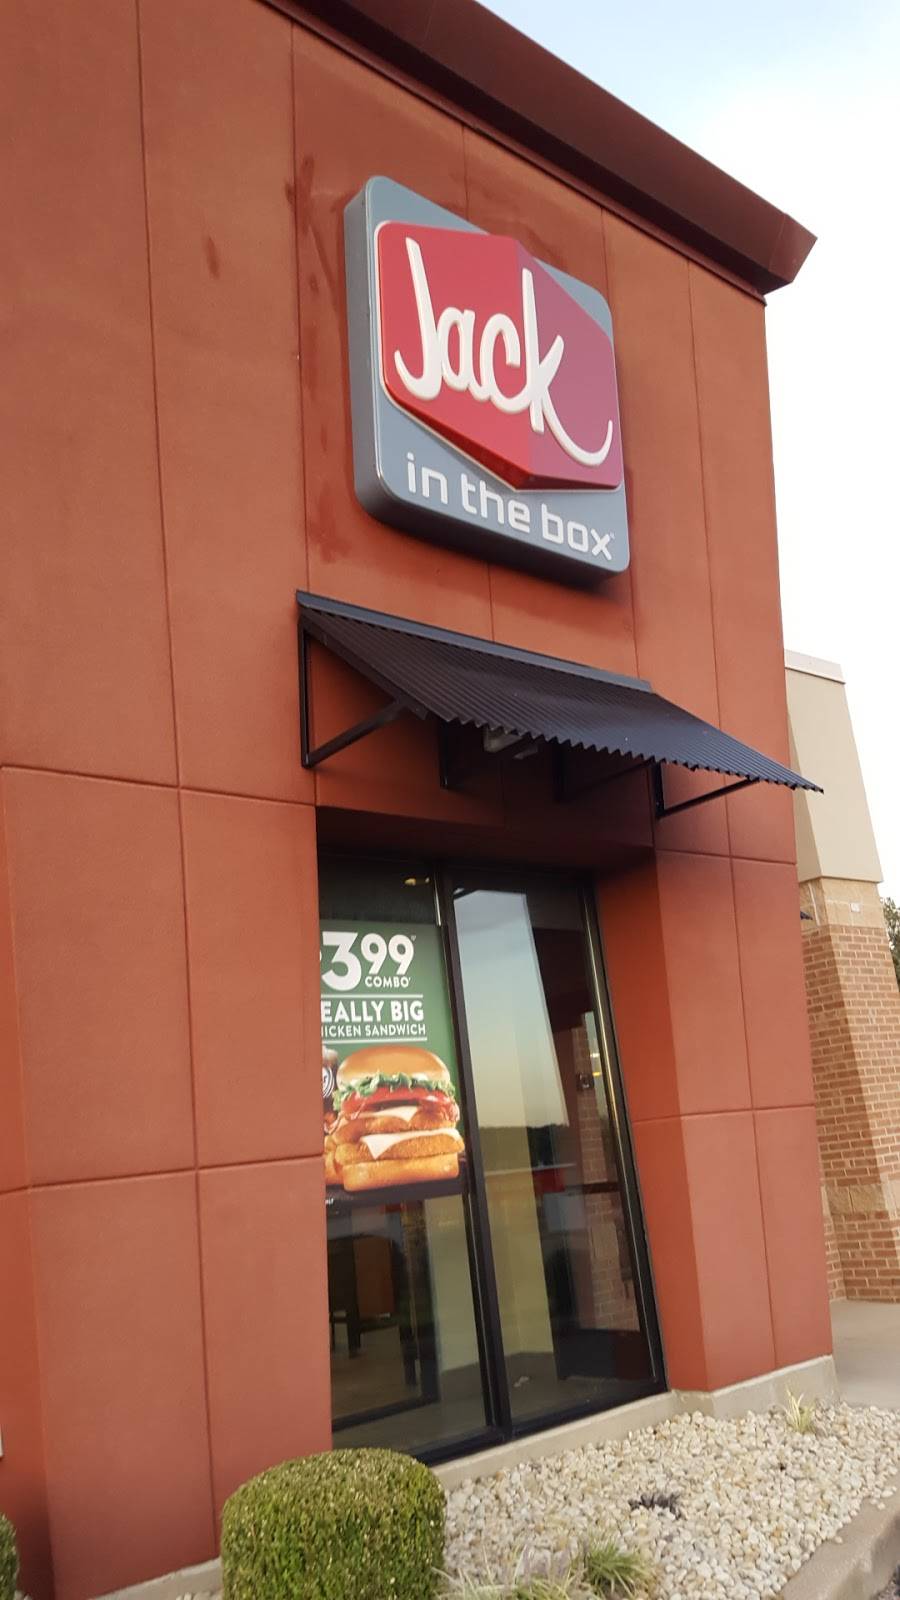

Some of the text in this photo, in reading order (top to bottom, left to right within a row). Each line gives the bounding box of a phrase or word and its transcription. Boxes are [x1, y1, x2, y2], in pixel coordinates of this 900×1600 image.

[394, 237, 613, 466] Jack
[406, 452, 612, 561] in the box
[320, 931, 414, 991] 399
[321, 1000, 425, 1023] EALLY BIG
[321, 1023, 427, 1037] ICKEN SANDWICH
